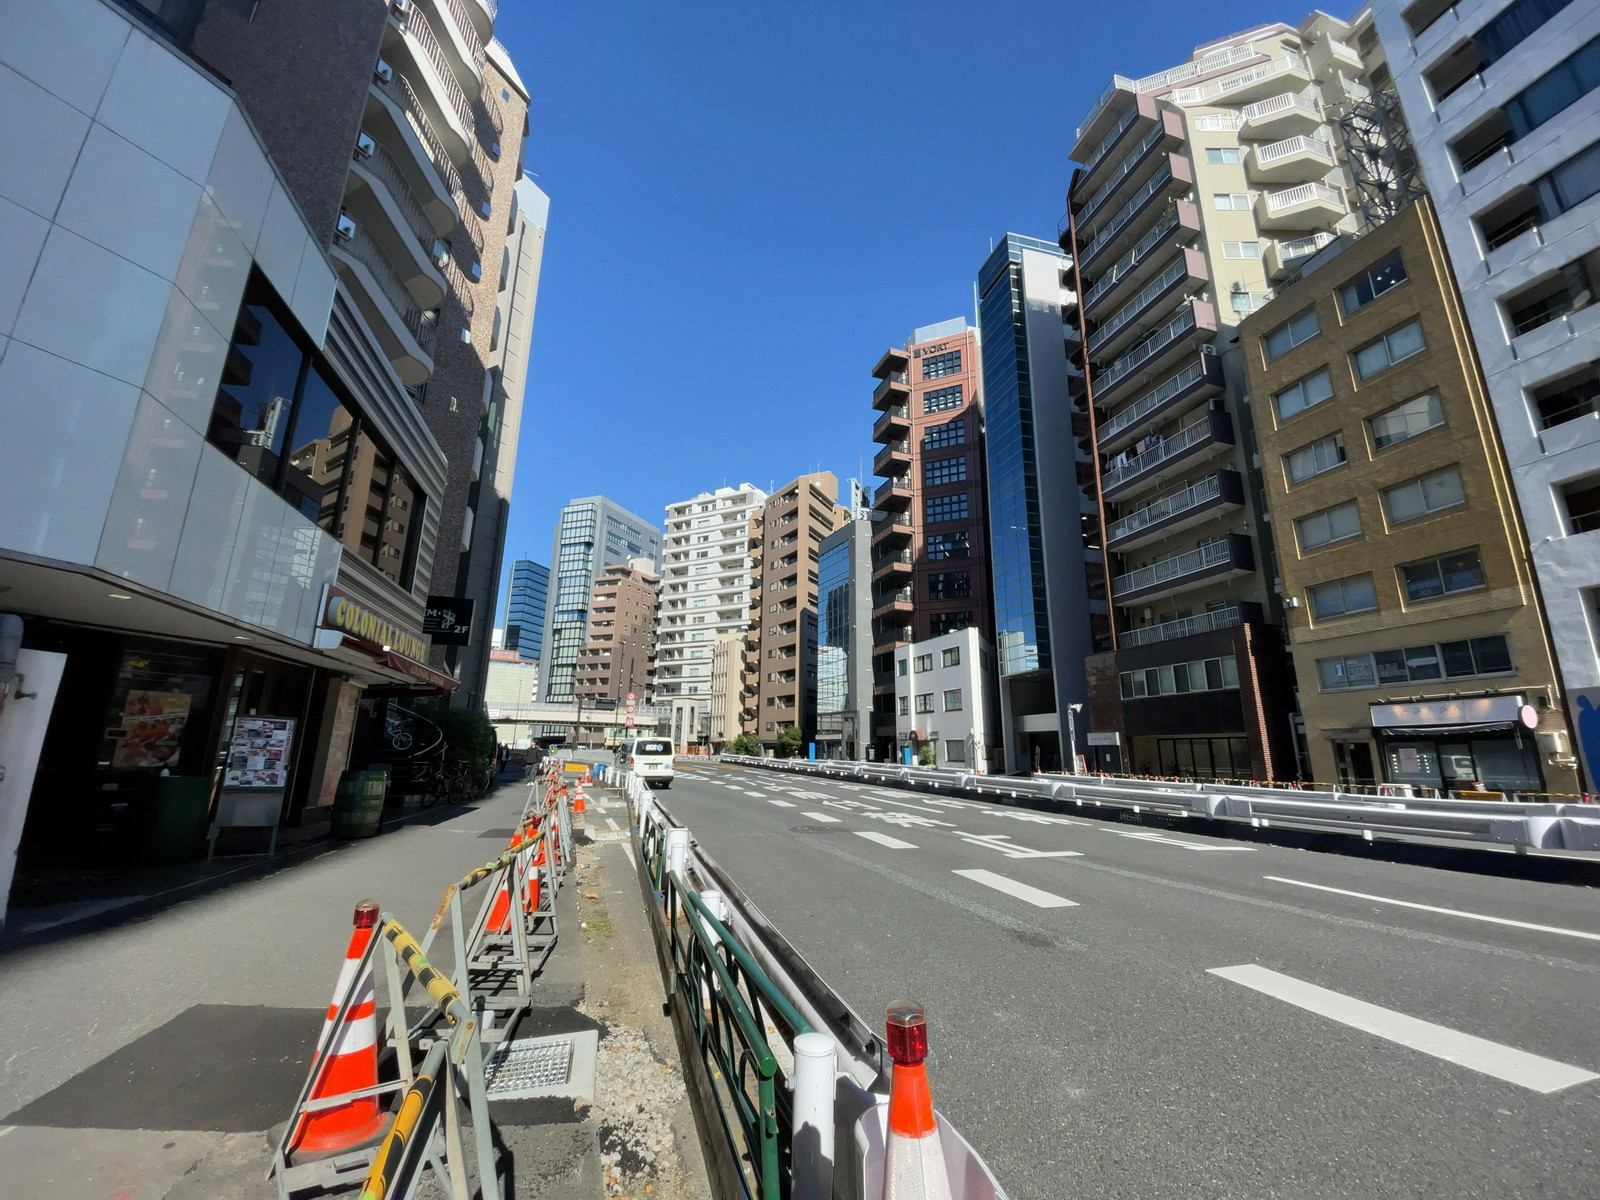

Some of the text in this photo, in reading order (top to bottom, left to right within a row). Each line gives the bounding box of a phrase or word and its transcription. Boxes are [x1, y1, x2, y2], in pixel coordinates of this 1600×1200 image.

[922, 342, 949, 355] VORT
[336, 599, 427, 663] COLONIAL LOUNGE
[453, 625, 470, 634] 2F
